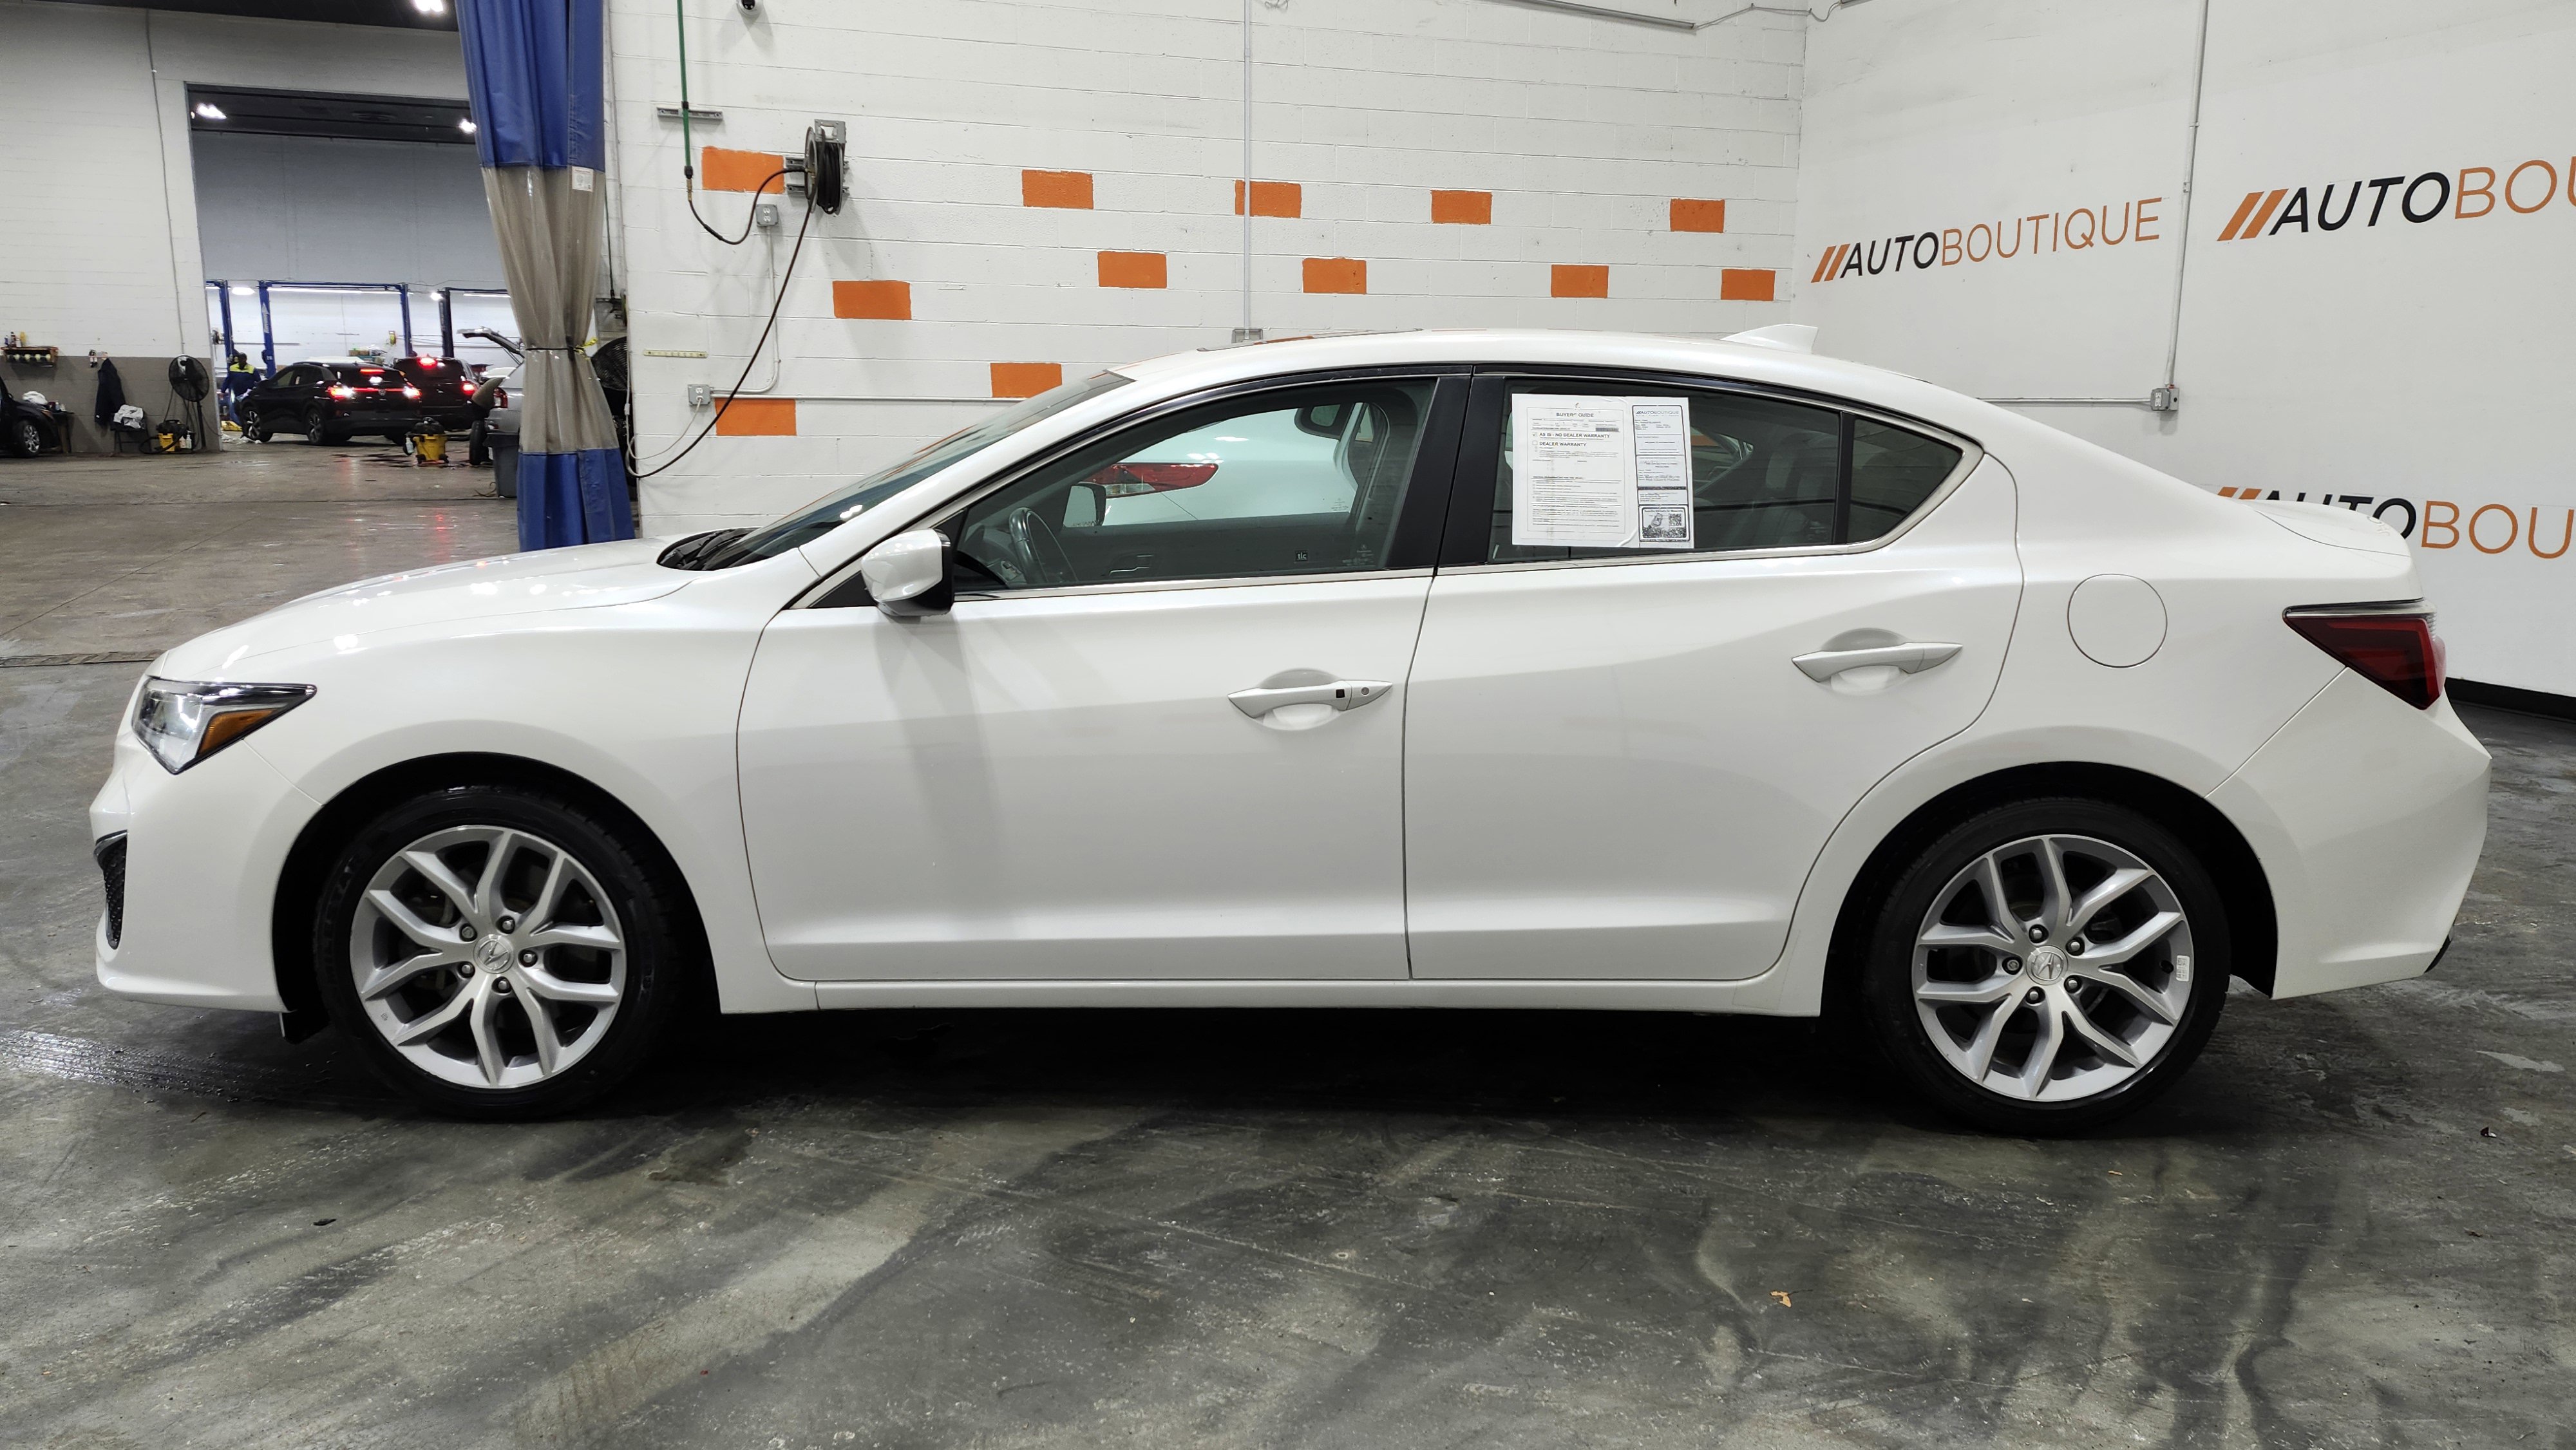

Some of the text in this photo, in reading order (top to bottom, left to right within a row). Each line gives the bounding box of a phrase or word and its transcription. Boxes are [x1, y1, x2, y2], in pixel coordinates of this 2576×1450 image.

[2268, 155, 2576, 236] AUTOBO
[1839, 197, 2163, 279] AUTOBOUTIQUE
[2266, 490, 2575, 560] OBOU
